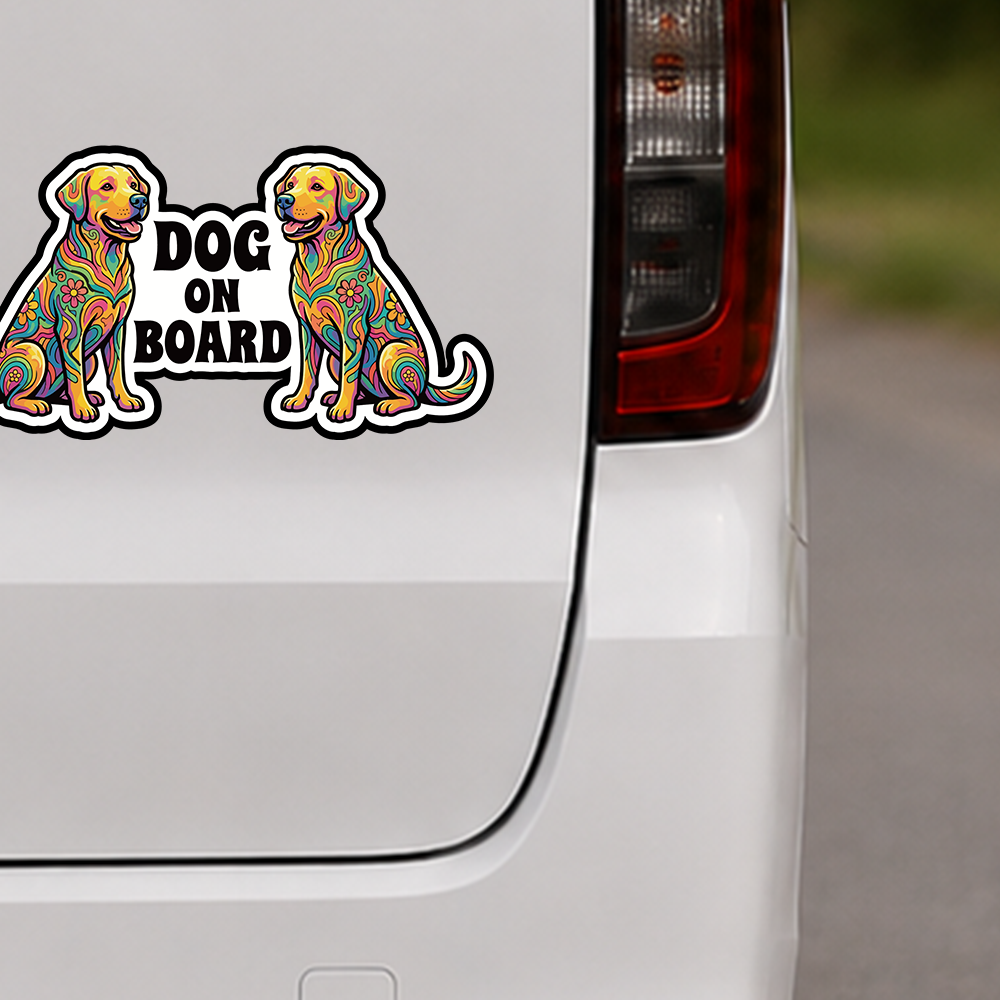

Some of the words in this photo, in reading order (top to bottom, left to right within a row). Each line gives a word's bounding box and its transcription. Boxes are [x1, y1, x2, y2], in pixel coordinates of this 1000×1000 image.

[153, 219, 271, 272] DOG
[184, 278, 240, 313] ON
[133, 319, 292, 364] BOARD
